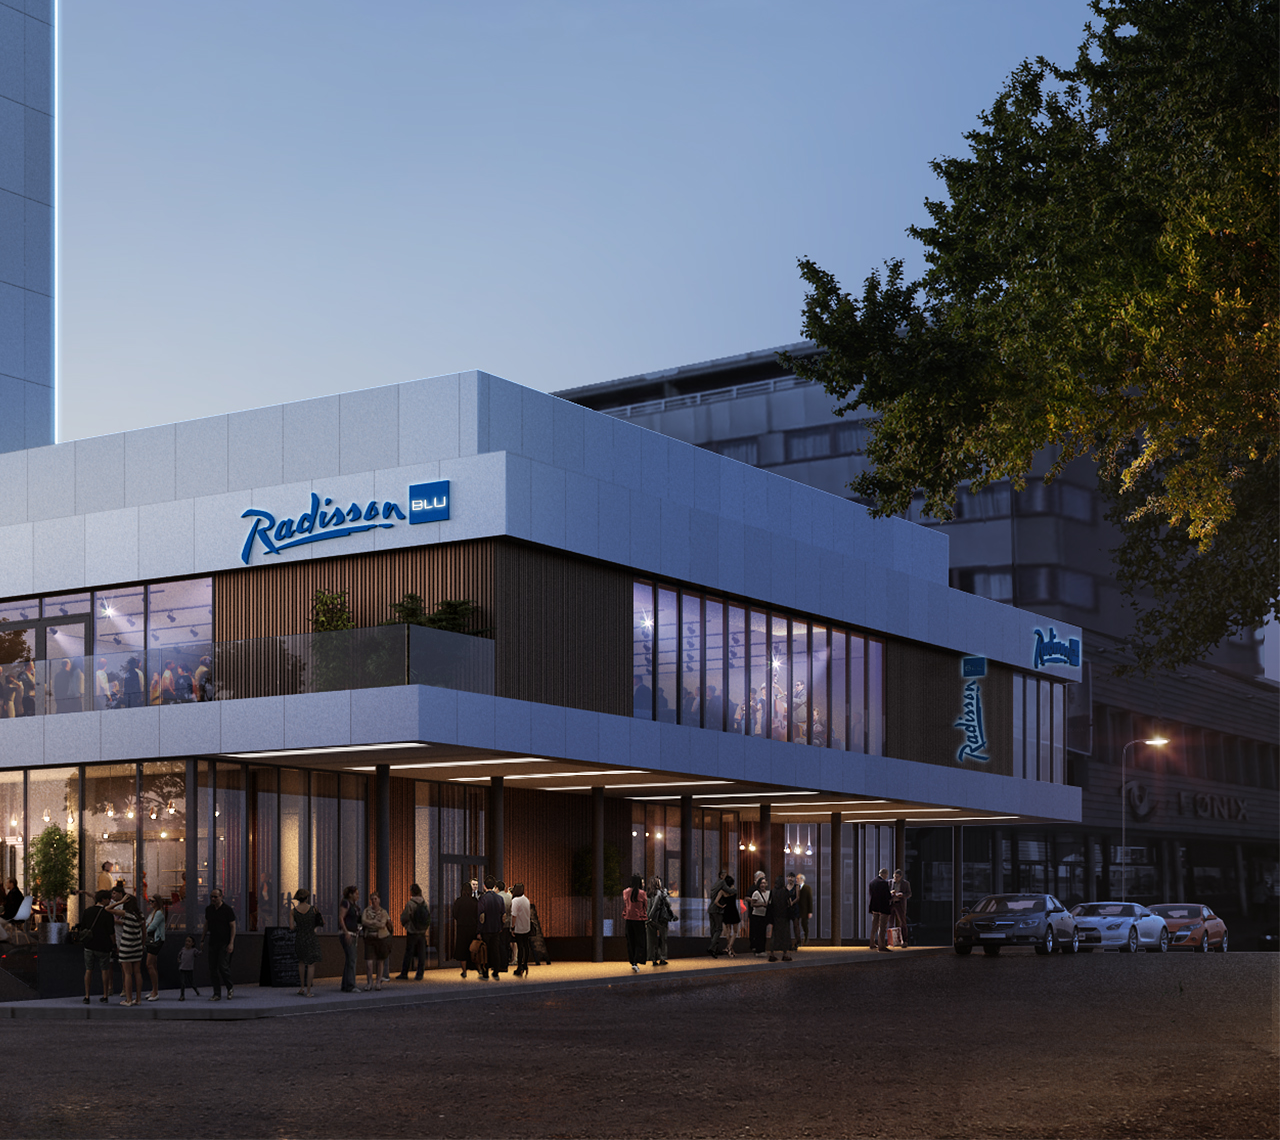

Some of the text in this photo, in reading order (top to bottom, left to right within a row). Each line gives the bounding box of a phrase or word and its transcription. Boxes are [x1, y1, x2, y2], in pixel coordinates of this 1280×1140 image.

[241, 492, 446, 565] Radisson BLU
[954, 680, 990, 762] Radisson
